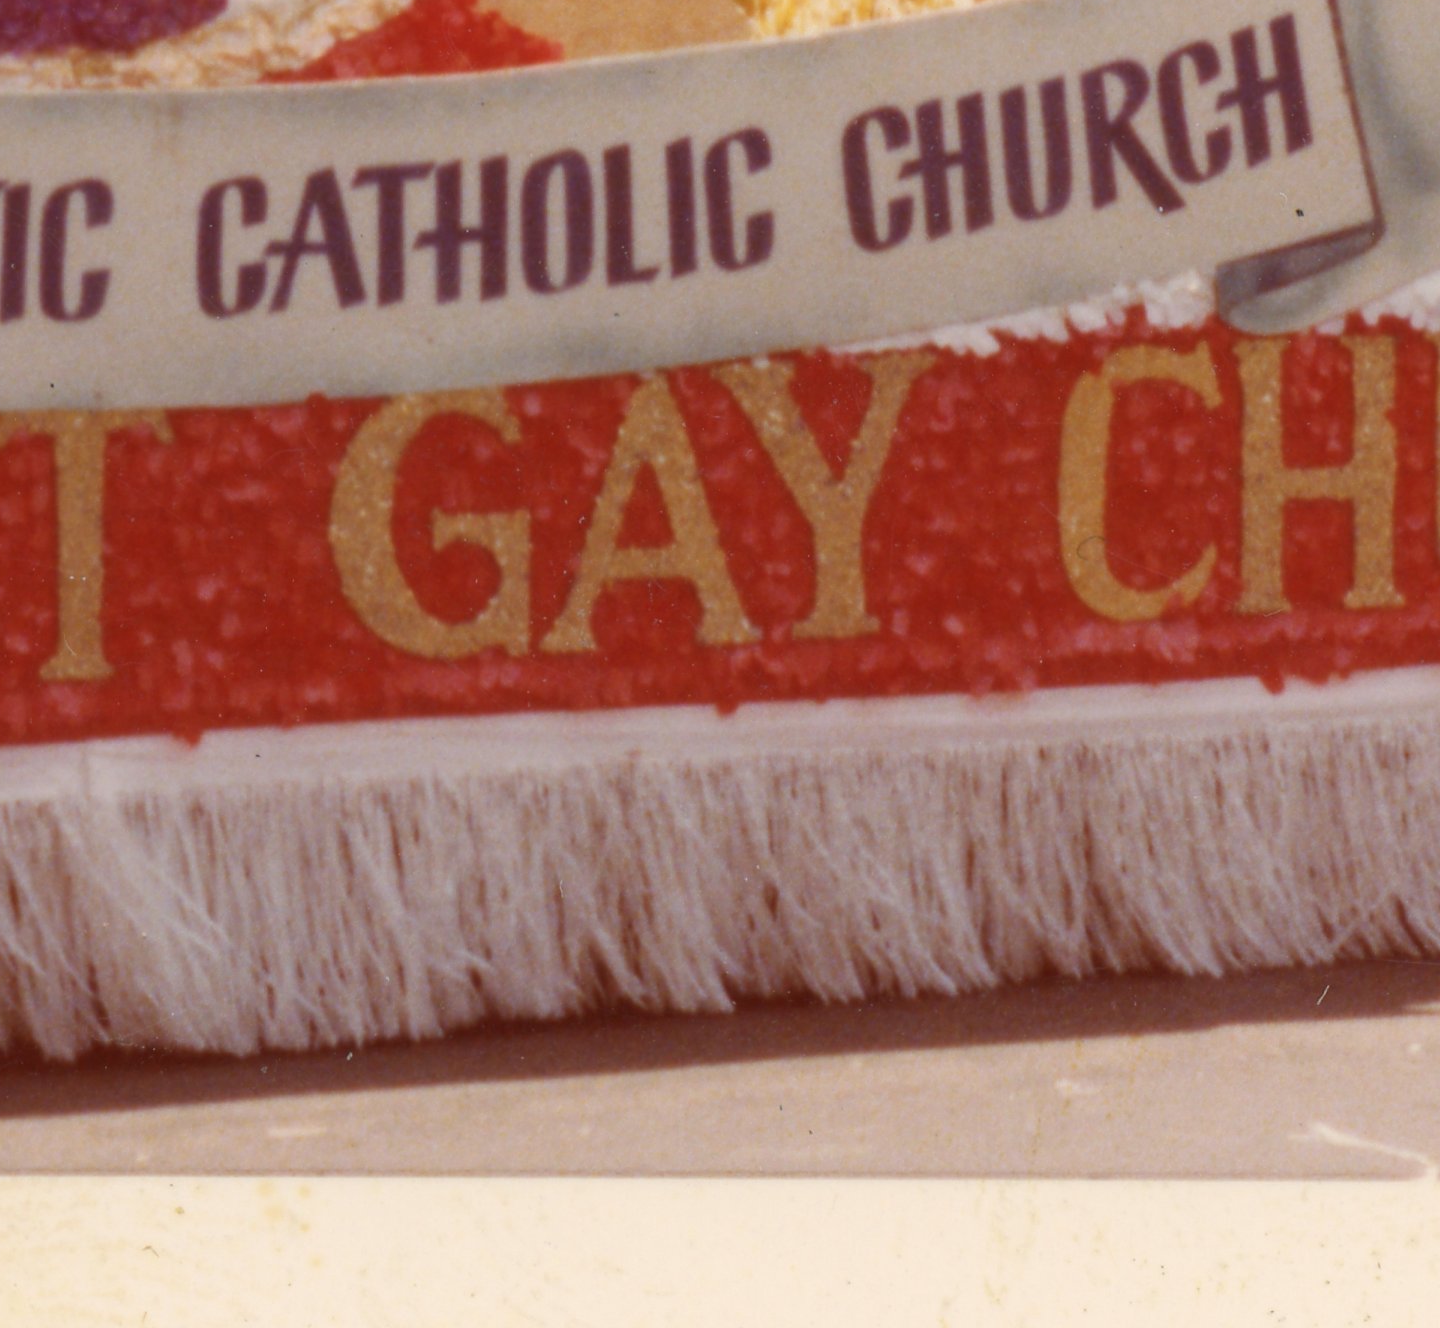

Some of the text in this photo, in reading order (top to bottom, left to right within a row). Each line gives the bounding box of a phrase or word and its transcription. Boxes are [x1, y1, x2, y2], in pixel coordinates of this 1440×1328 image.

[195, 126, 775, 320] CATHOLIC
[840, 12, 1312, 252] CHURCH
[330, 354, 920, 662] GAY
